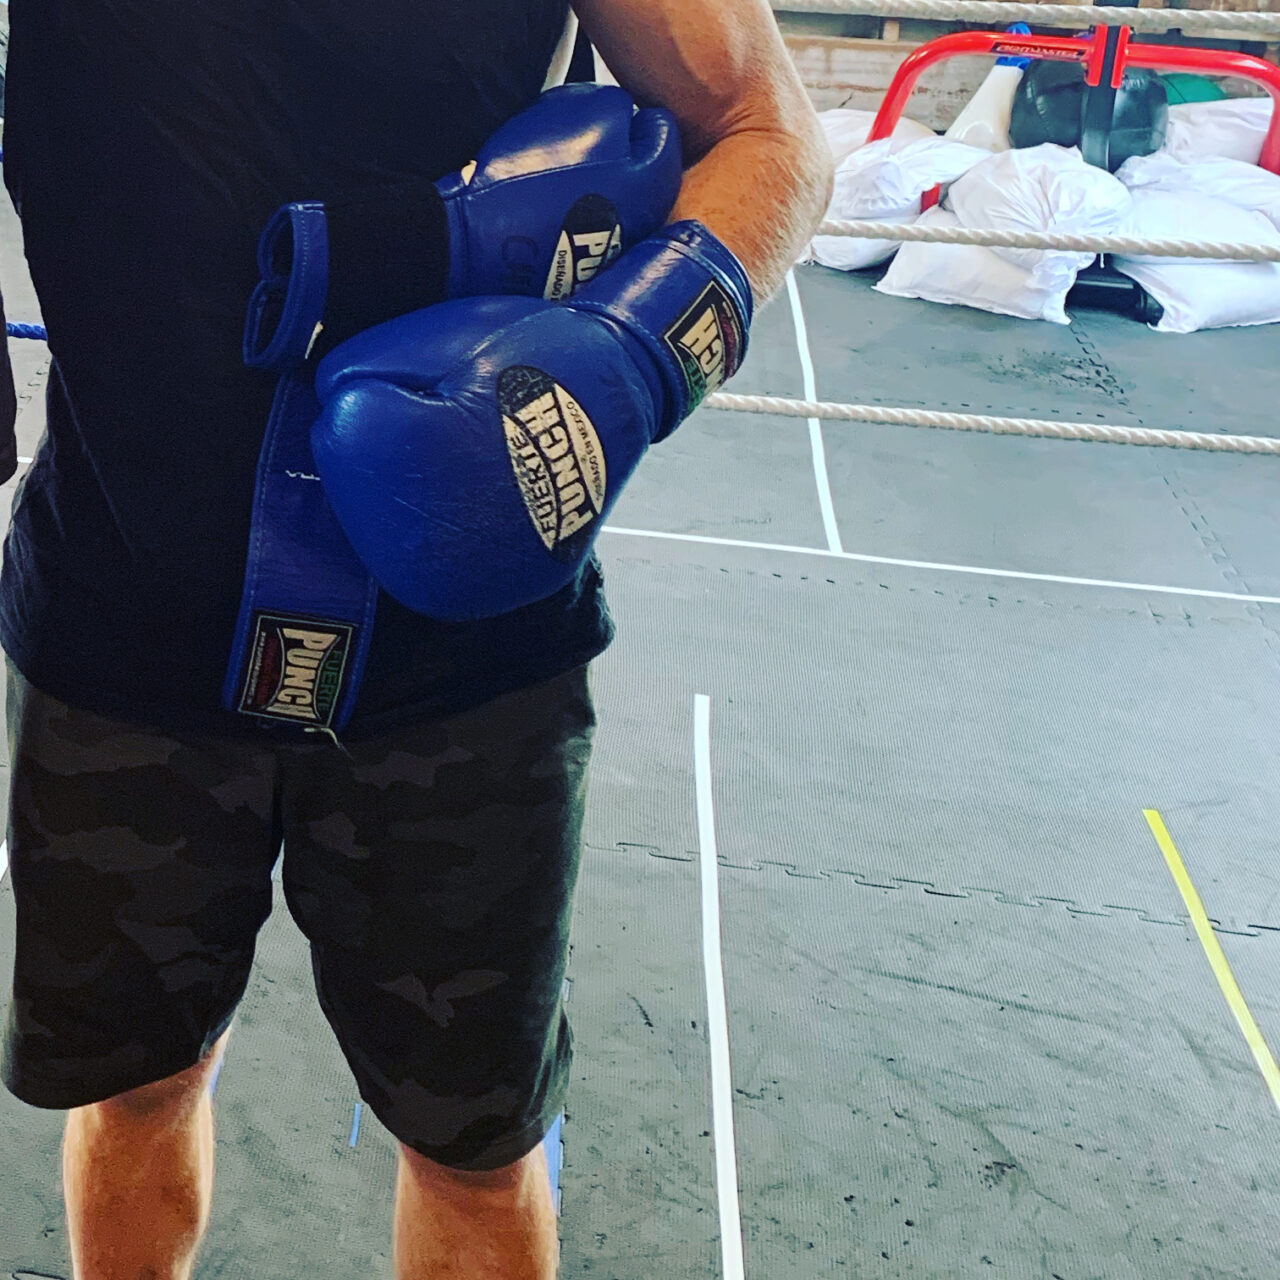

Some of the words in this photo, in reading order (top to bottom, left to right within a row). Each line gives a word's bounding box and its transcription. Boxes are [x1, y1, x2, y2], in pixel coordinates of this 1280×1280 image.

[509, 431, 556, 534] FUERTE
[514, 391, 595, 540] PUNCH
[266, 628, 338, 719] PUNCH
